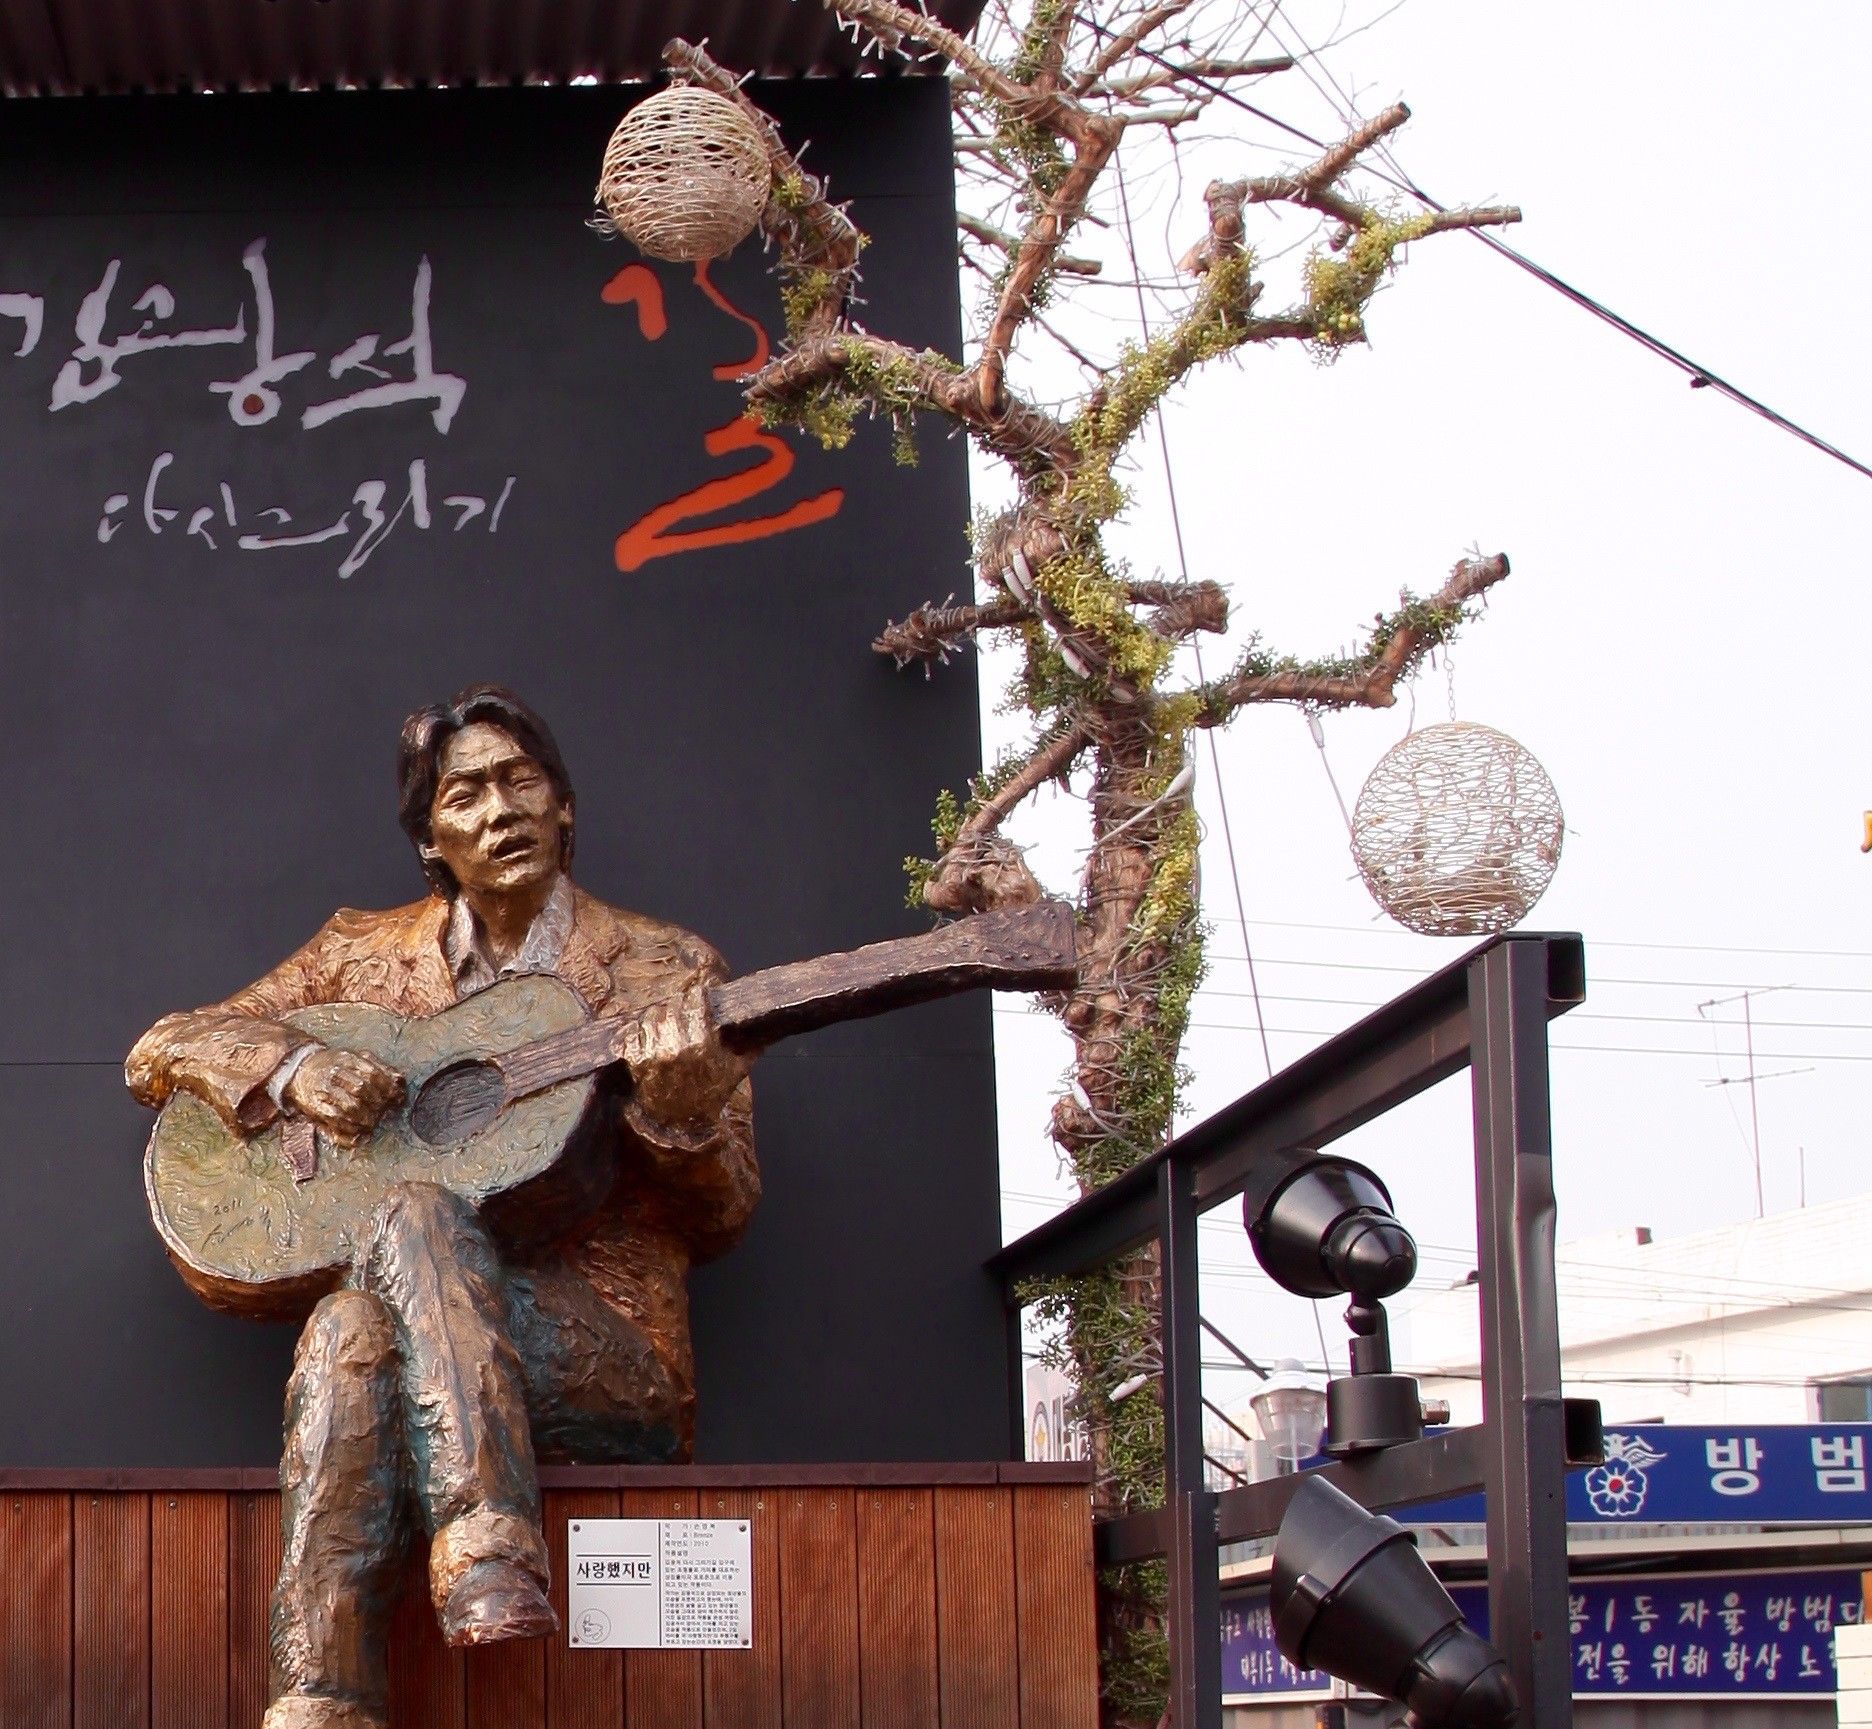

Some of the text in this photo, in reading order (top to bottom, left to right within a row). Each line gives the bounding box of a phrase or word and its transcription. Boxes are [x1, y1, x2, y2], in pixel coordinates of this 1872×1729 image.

[577, 1560, 652, 1579] 사랑했지만
[1678, 1592, 1746, 1635] 자율
[1650, 1644, 1709, 1680] 위해
[1722, 1642, 1781, 1682] 항상
[1797, 1640, 1837, 1678] 노
